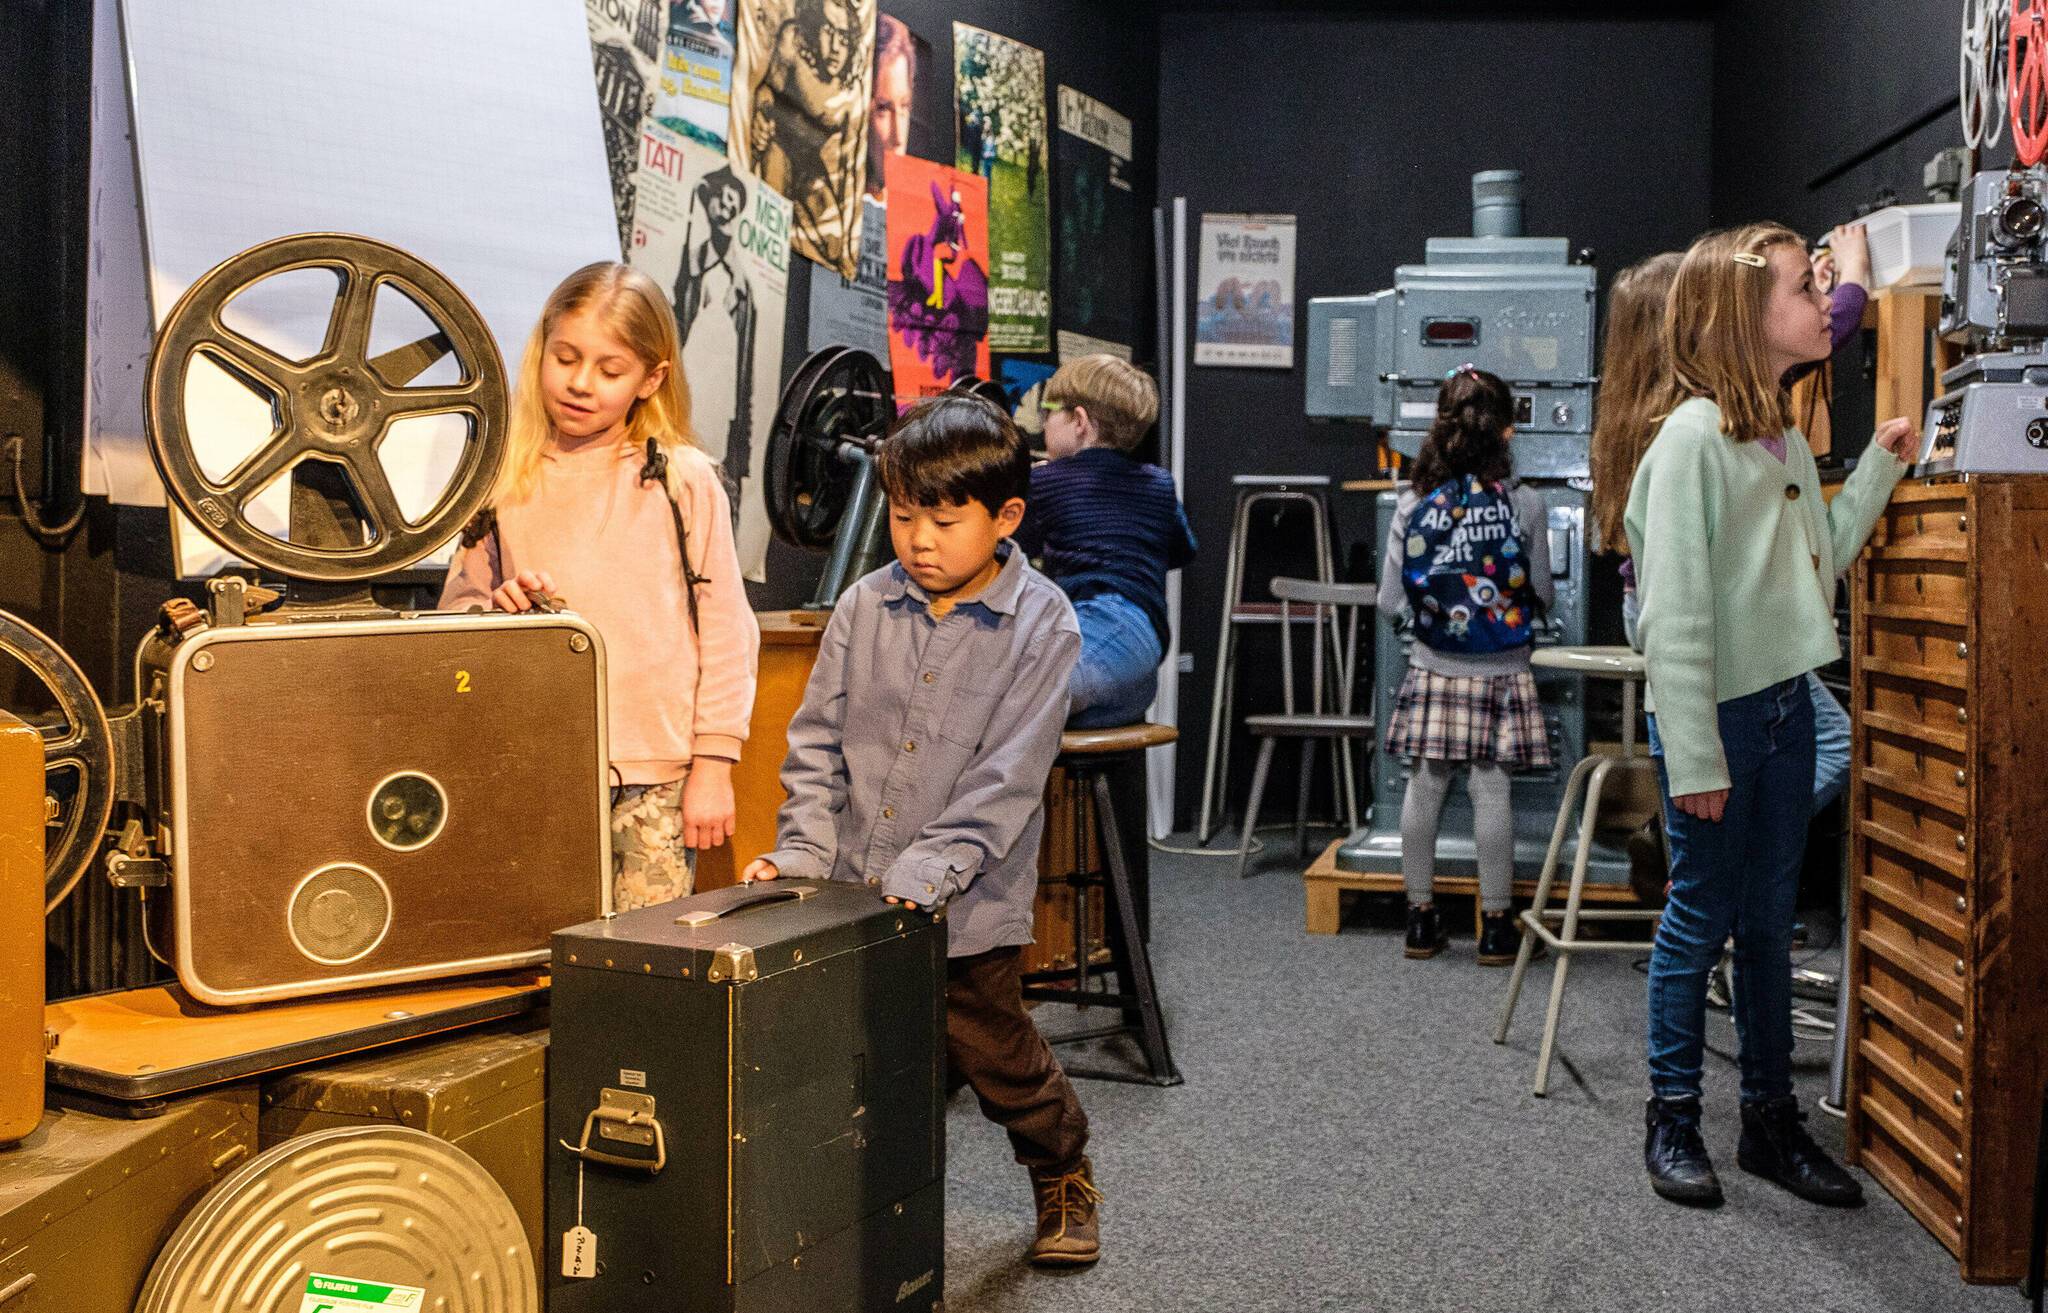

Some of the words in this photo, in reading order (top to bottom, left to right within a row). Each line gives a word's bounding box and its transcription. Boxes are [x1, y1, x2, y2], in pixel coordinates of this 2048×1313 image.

[643, 134, 684, 182] TATI
[739, 219, 786, 272] ONKEL
[1420, 507, 1453, 531] Ab
[455, 670, 471, 693] 2
[322, 1281, 359, 1293] FUJIFILM
